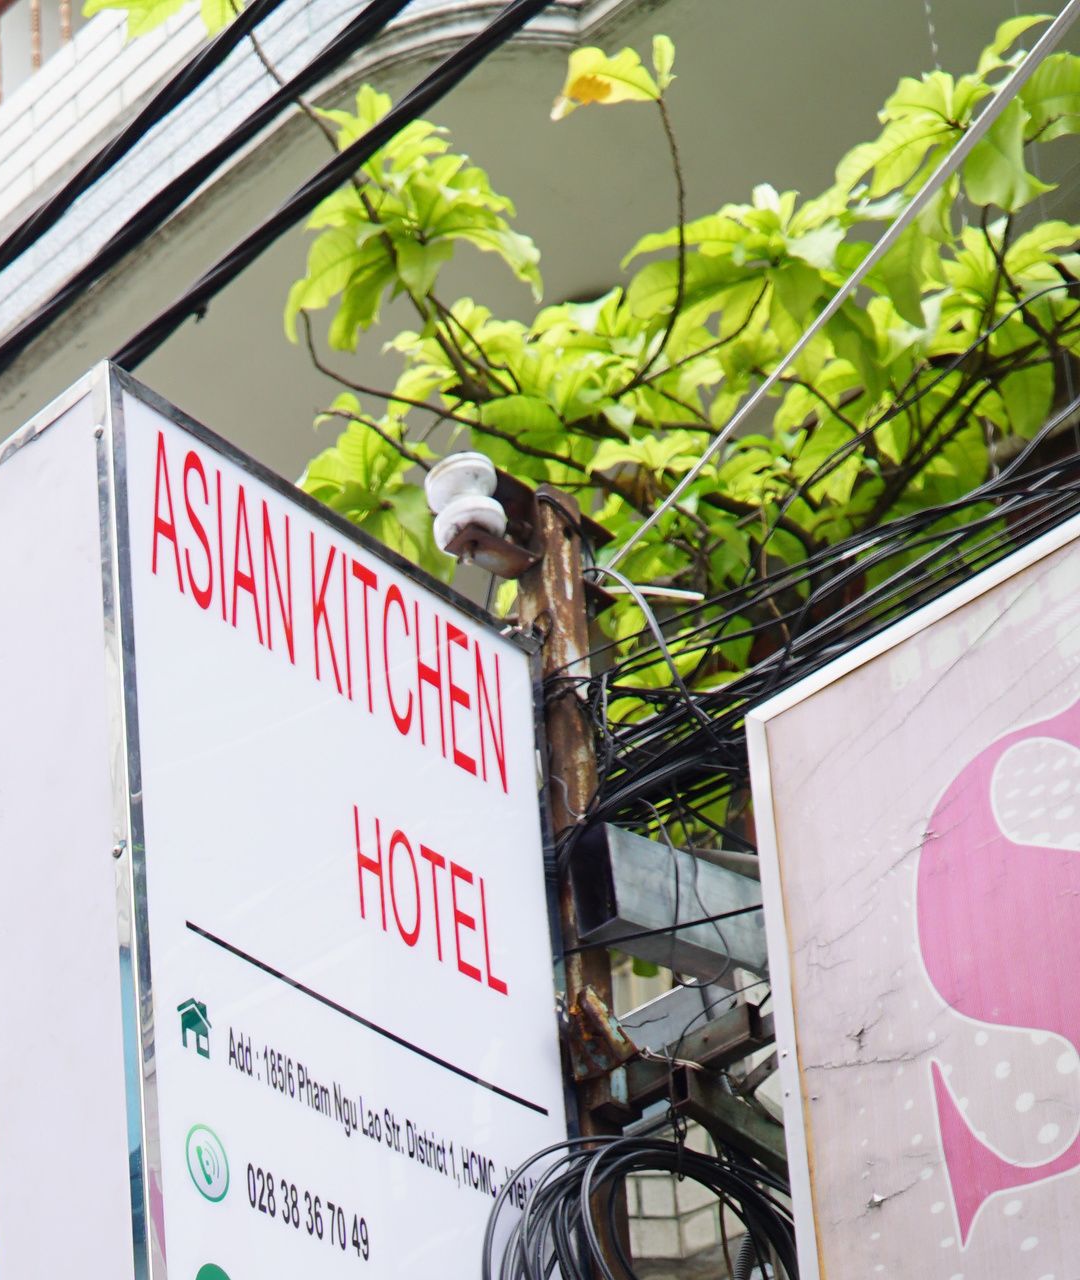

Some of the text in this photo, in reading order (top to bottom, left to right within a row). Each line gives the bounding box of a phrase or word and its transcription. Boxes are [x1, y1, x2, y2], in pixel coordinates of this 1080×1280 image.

[152, 430, 508, 794] ASIAN KITCHEN
[353, 805, 508, 996] HOTEL
[229, 1027, 253, 1076] Add
[264, 1045, 294, 1098] 185/6
[297, 1062, 331, 1117] Pham
[333, 1082, 357, 1137] Ngu
[360, 1096, 381, 1143] Lao
[384, 1108, 405, 1154] Str.
[406, 1119, 448, 1176] District
[461, 1146, 497, 1198] HCMC
[248, 1163, 369, 1261] 028 38 36 70 49
